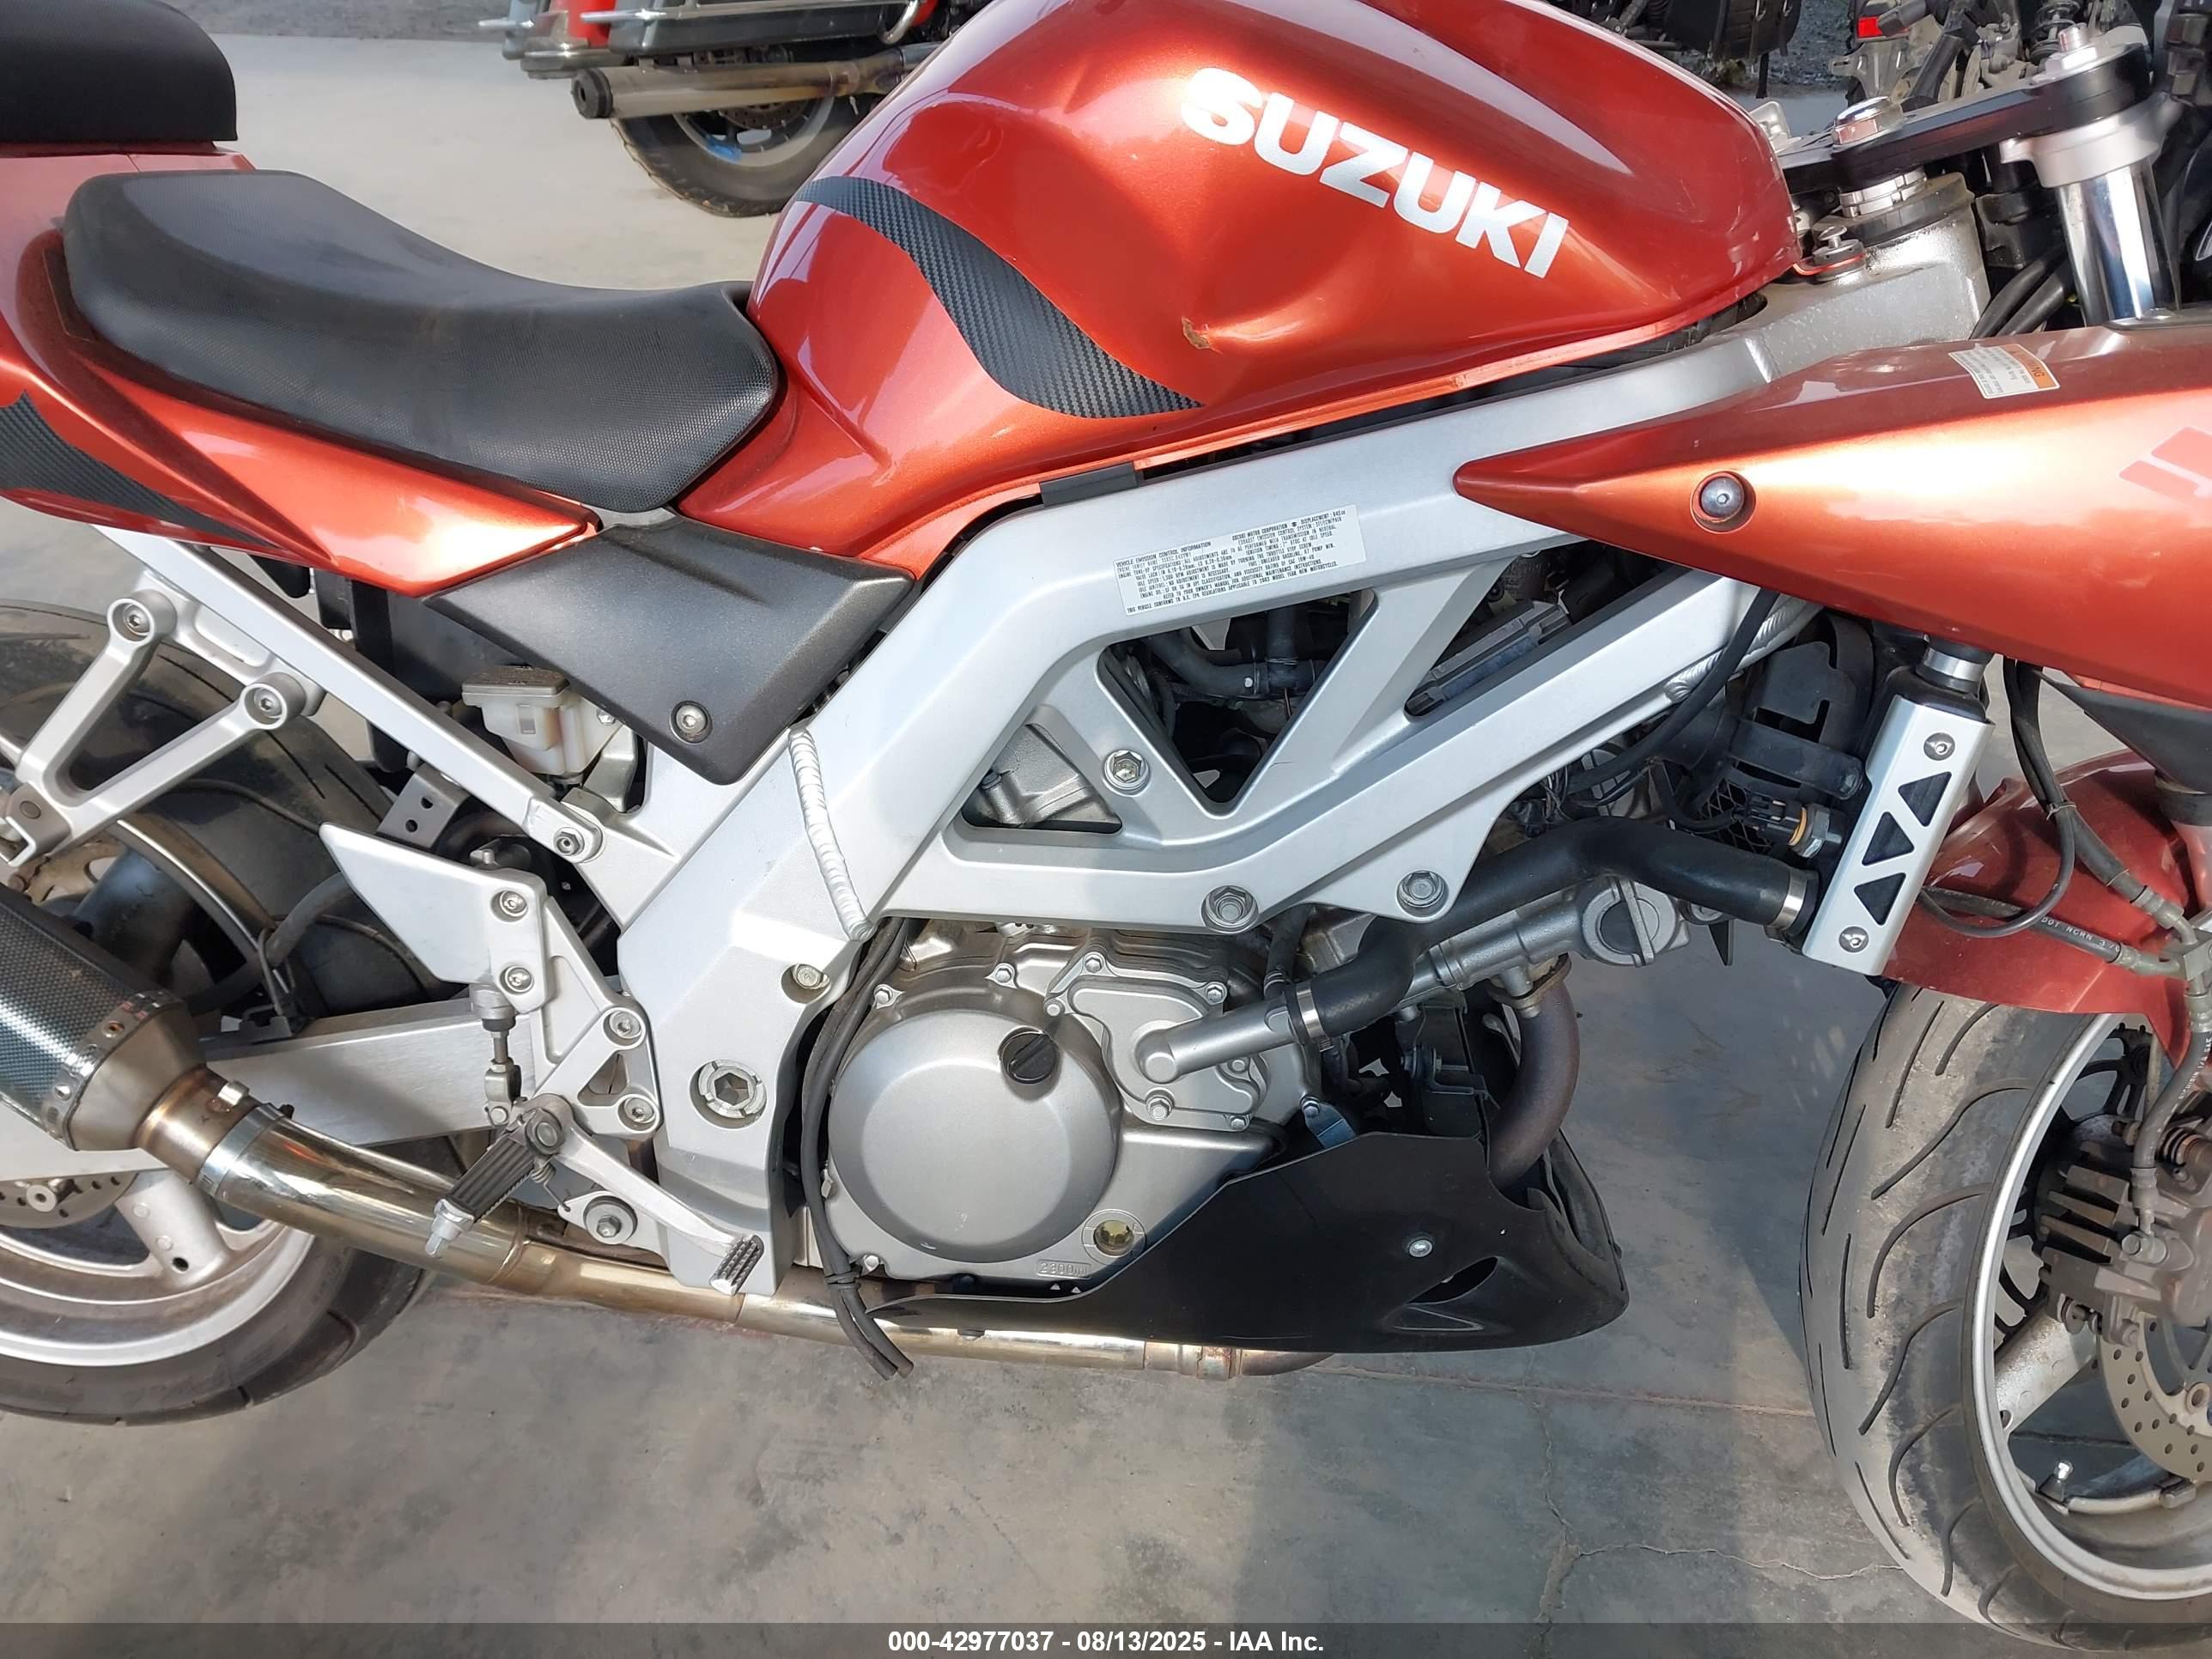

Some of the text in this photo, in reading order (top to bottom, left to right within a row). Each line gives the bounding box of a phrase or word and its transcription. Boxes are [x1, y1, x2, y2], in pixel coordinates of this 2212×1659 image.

[1181, 68, 1569, 278] SUZUKI
[1261, 524, 1287, 533] CORPORATION
[1115, 559, 1133, 568] VEHICLE
[1158, 549, 1178, 557] CONTROL
[2040, 916, 2060, 927] DOT
